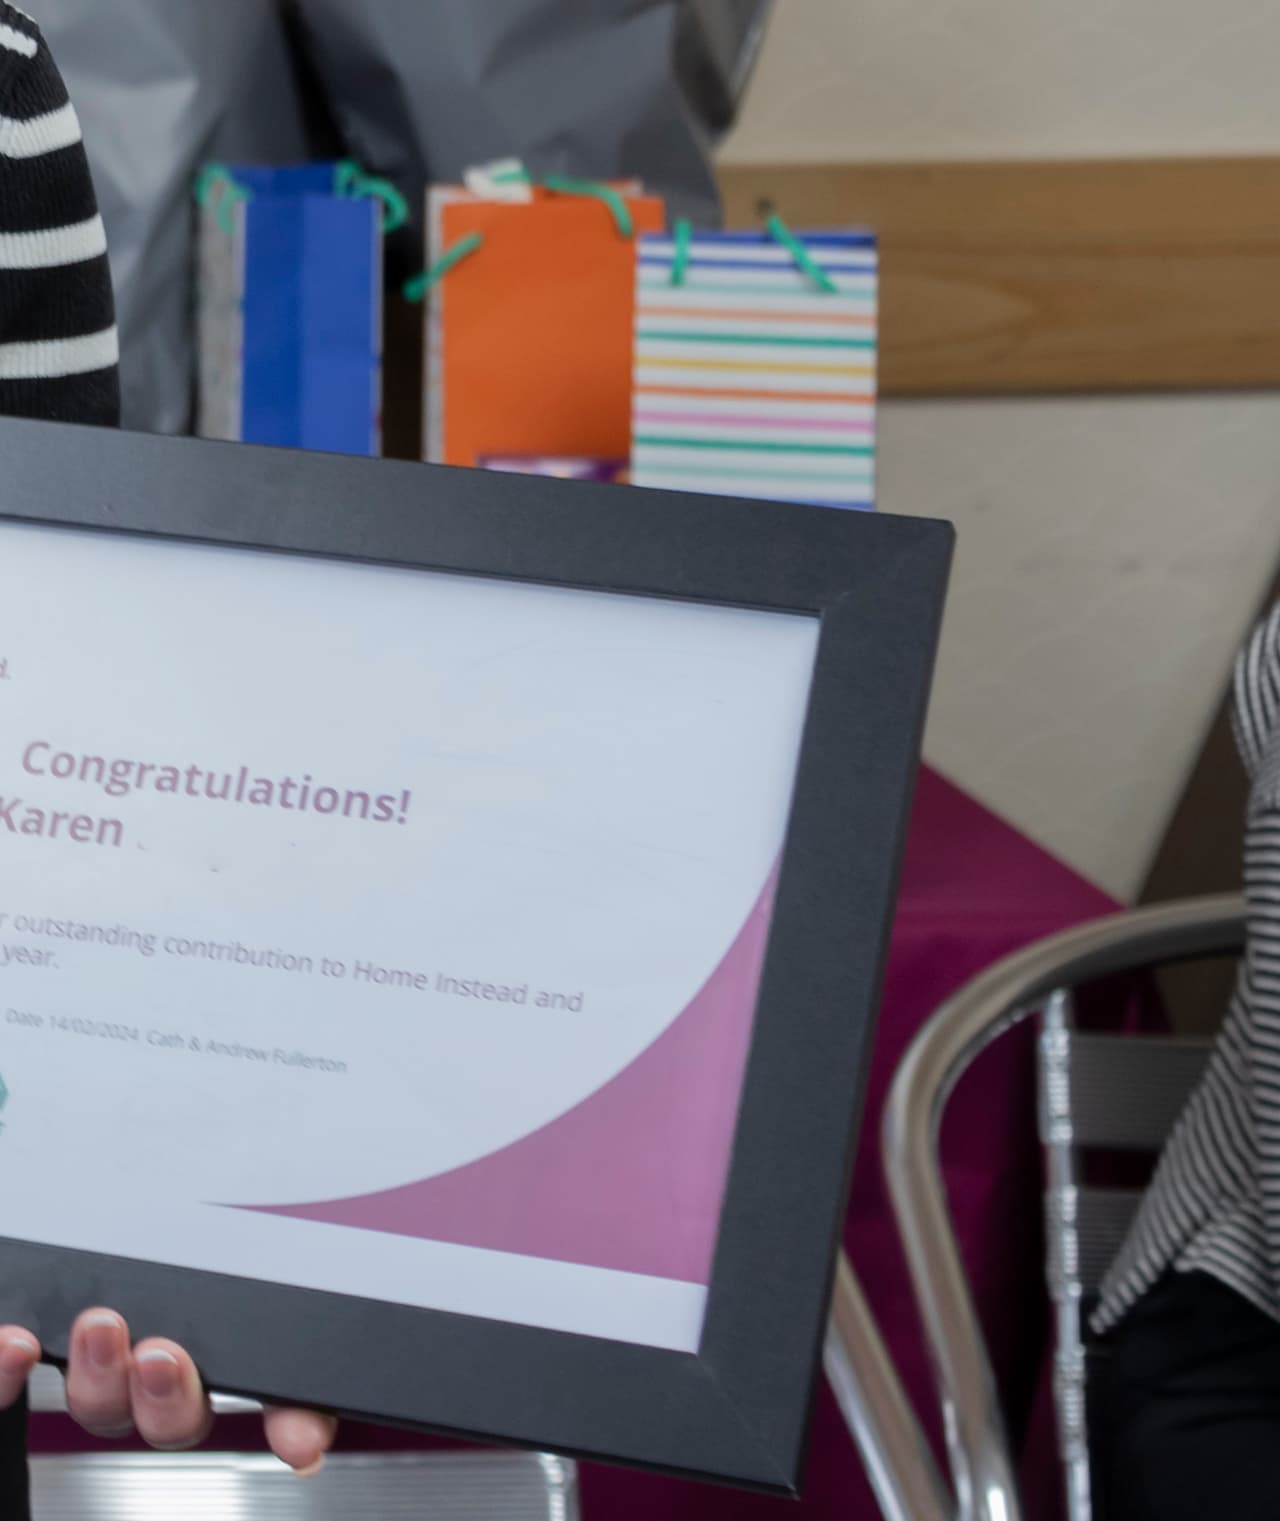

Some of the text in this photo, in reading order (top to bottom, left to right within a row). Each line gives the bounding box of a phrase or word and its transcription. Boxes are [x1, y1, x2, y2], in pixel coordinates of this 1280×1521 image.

[21, 739, 411, 825] Congratulations!
[13, 913, 157, 958] outstanding
[163, 932, 314, 975] contribution
[319, 955, 347, 980] to
[352, 960, 429, 992] Home
[435, 972, 529, 1007] Instead
[534, 987, 586, 1014] and
[188, 1035, 203, 1054] &
[205, 1039, 270, 1063] Andrew
